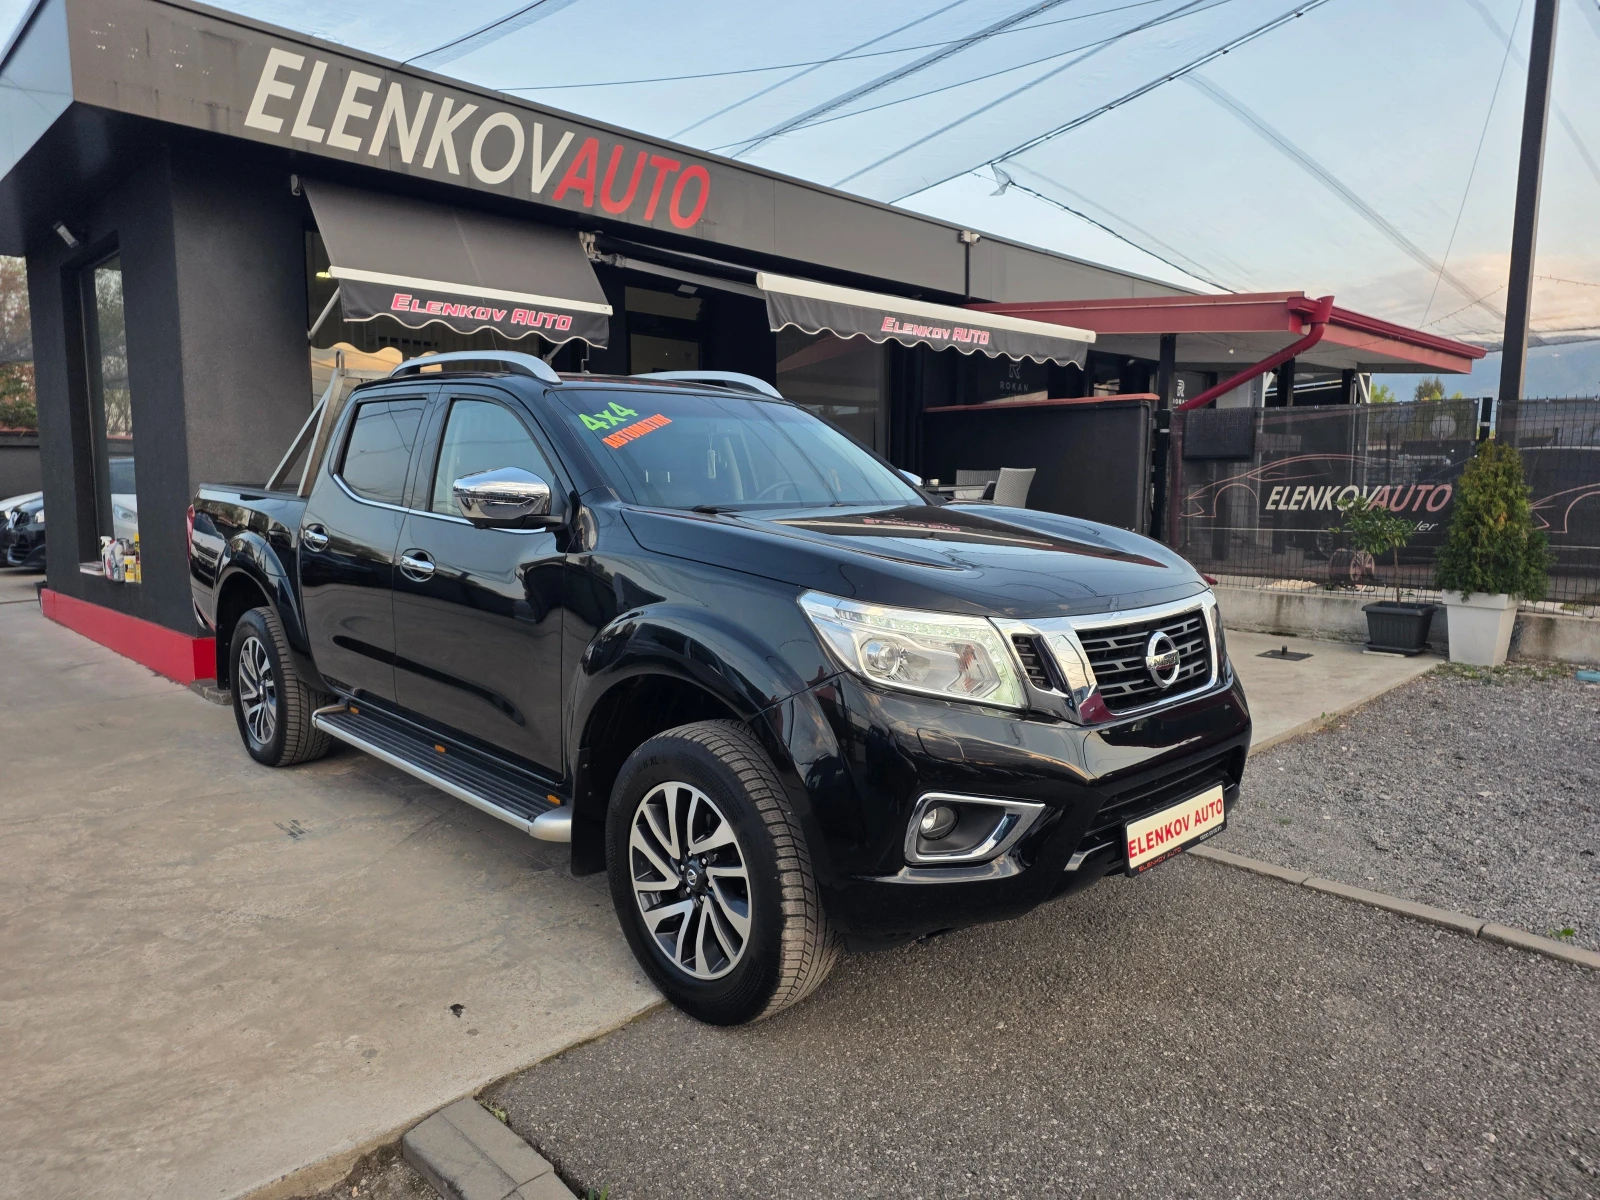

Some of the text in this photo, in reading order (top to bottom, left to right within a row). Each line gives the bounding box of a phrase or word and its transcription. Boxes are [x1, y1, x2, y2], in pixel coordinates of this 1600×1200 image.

[244, 47, 710, 229] ELENKOVAUTO
[391, 293, 573, 331] ELENKOV AUTO
[881, 316, 990, 345] ELENKOV AUTO
[1000, 381, 1029, 392] ROKAN
[1265, 484, 1452, 512] ELENKOVAUTO
[1128, 814, 1190, 859] ELENKOV
[1194, 798, 1223, 827] AUTO
